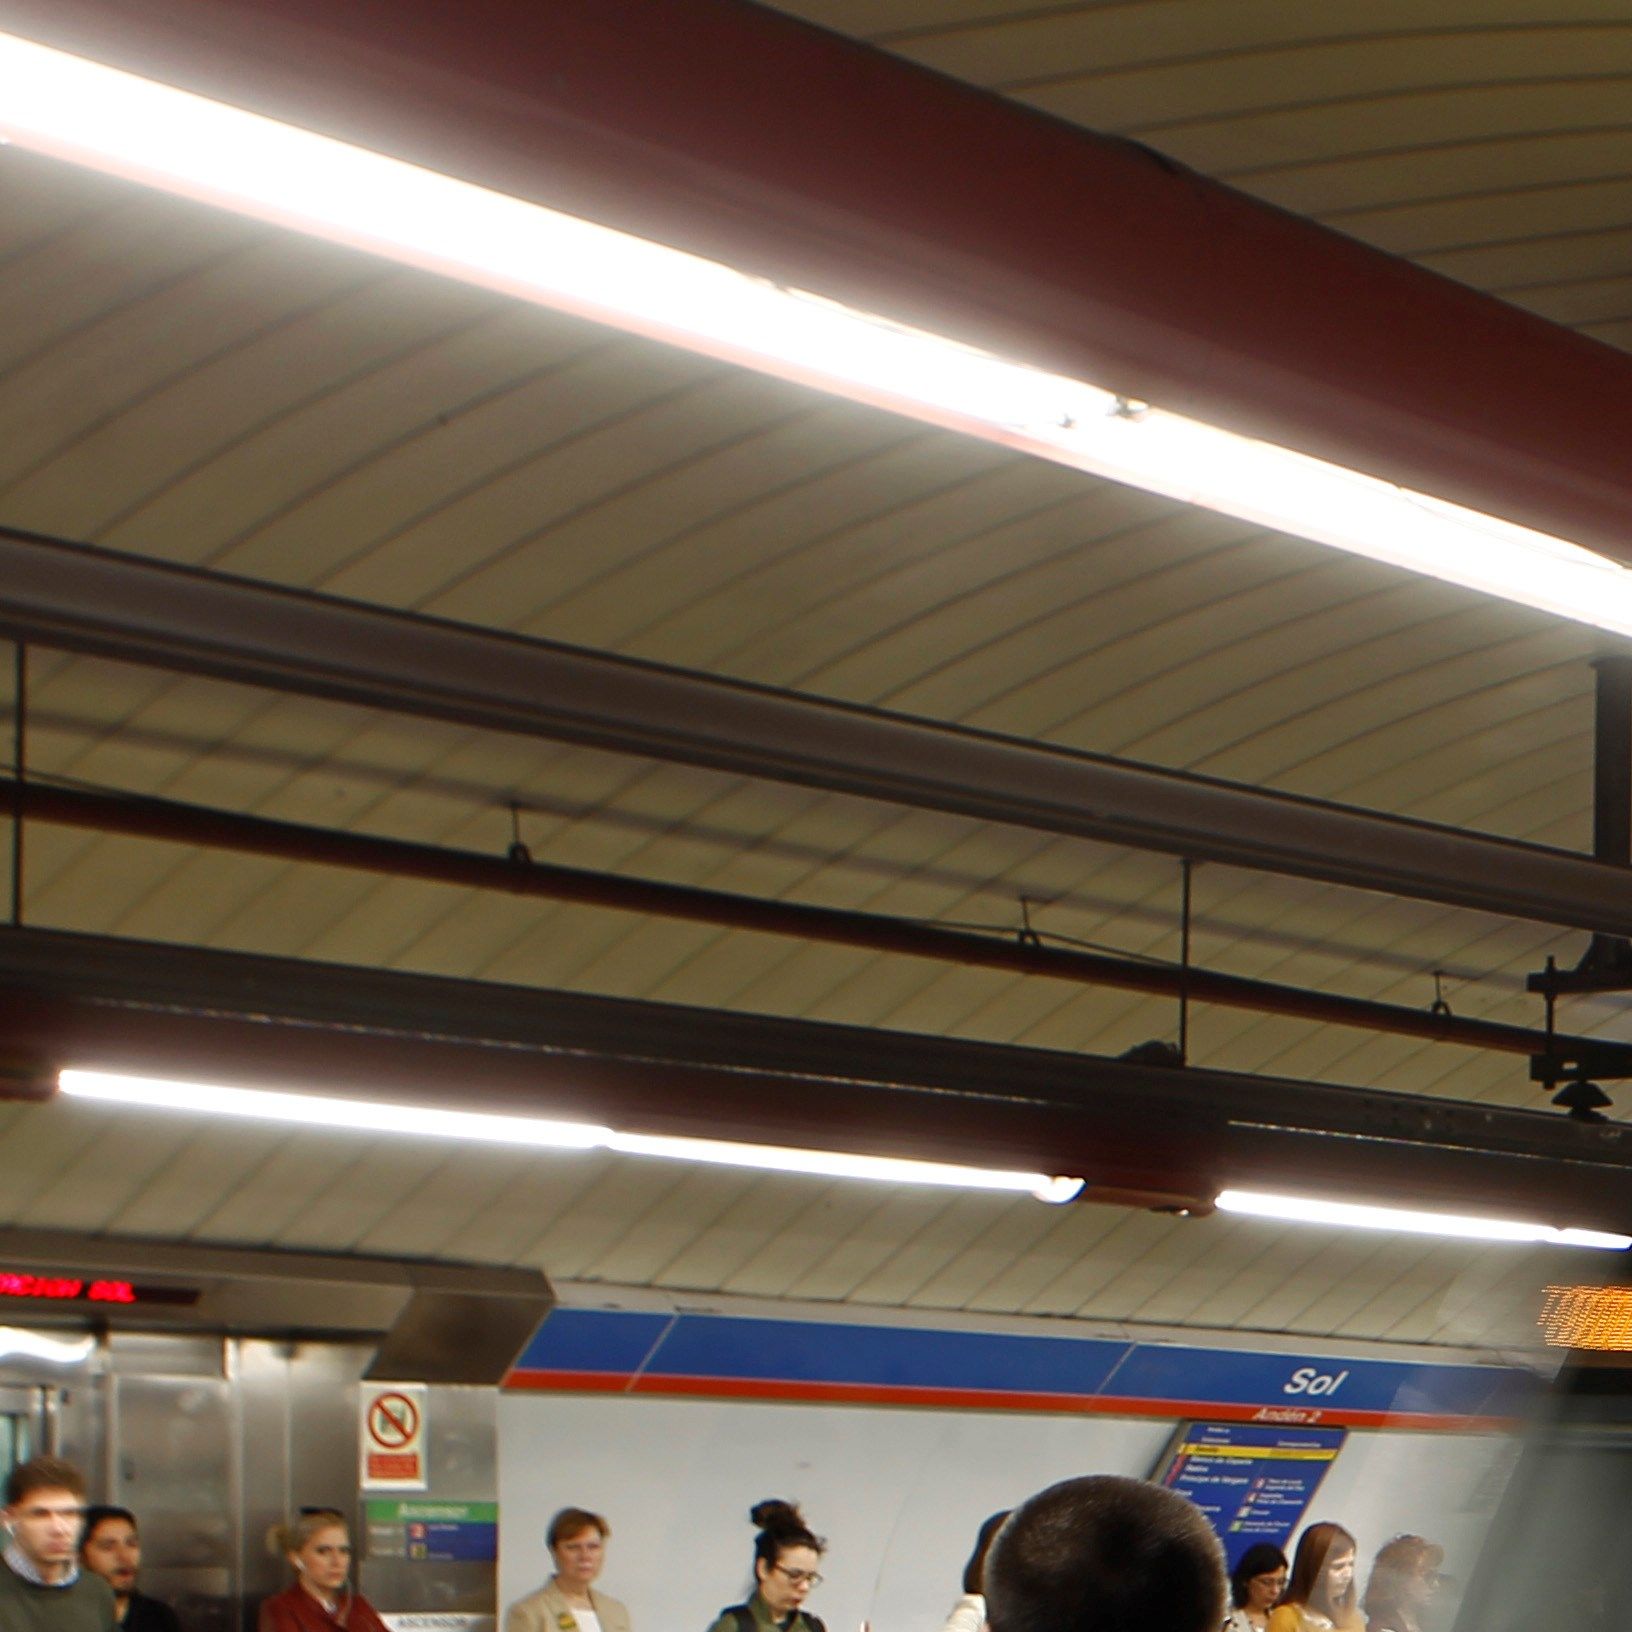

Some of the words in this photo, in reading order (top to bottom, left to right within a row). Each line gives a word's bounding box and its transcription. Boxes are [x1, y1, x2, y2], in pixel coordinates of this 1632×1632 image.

[1283, 1367, 1350, 1396] Sol
[1251, 1406, 1308, 1423] Andén
[1306, 1410, 1323, 1424] 2
